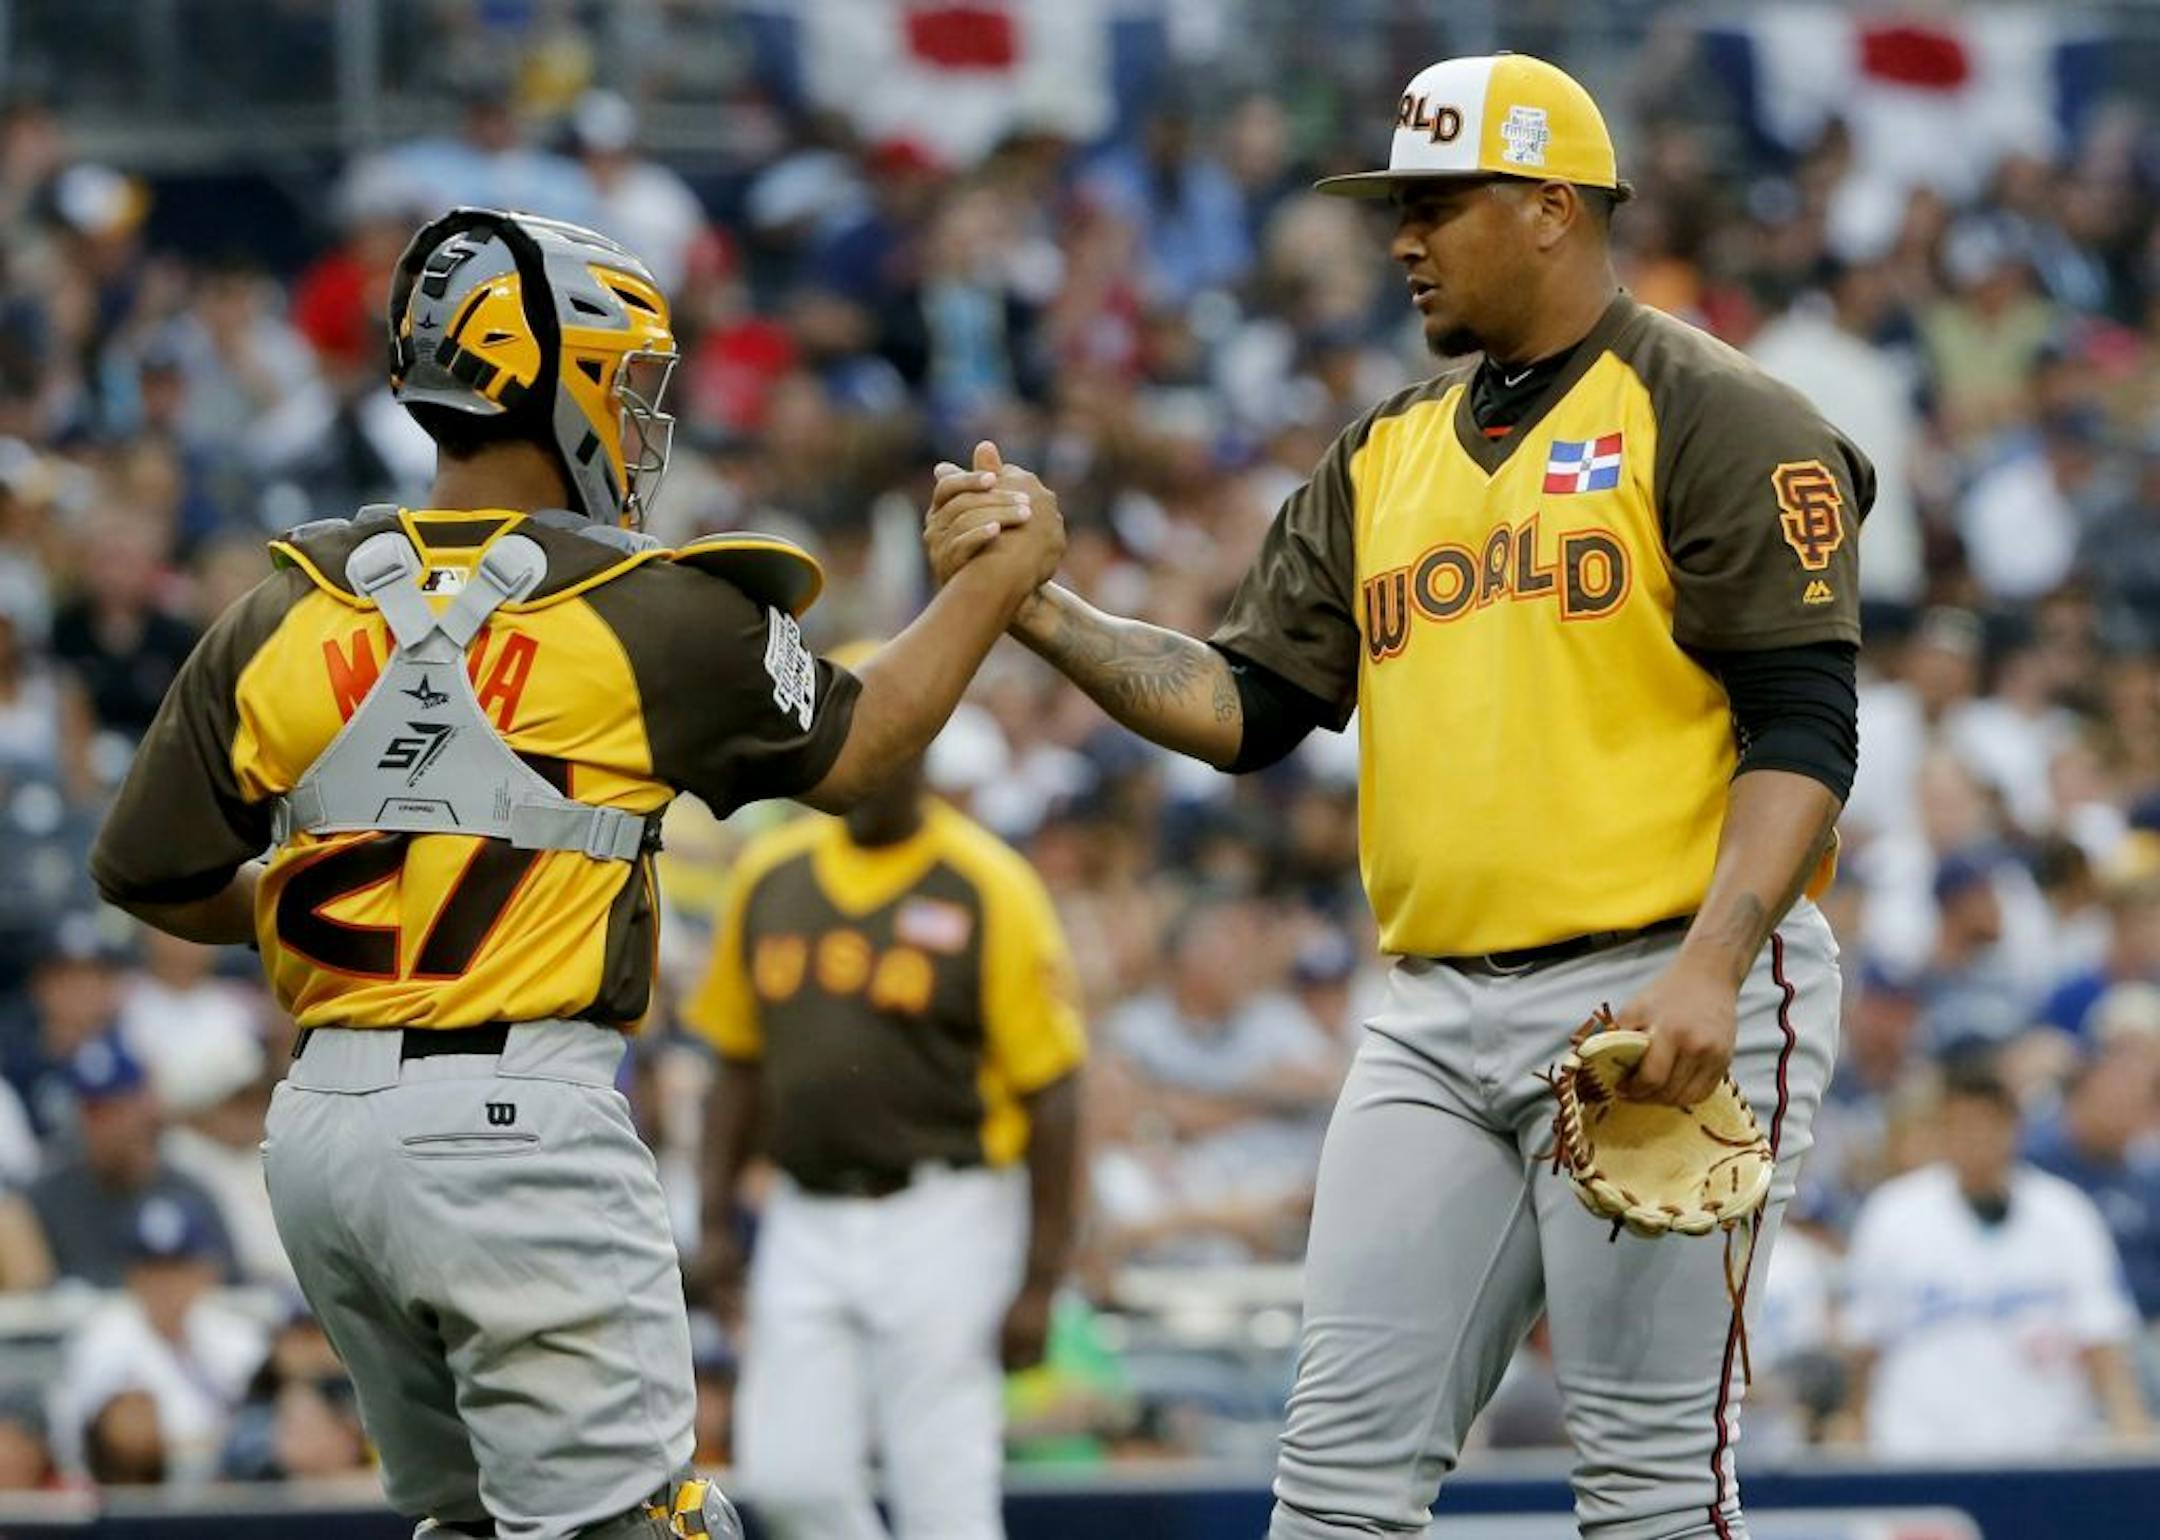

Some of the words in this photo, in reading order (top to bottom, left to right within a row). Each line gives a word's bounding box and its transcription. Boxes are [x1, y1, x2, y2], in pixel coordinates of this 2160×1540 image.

[1396, 93, 1464, 143] RLD
[1363, 511, 1632, 664] WORLD
[322, 625, 539, 735] MIA
[276, 746, 575, 981] 27
[754, 928, 936, 1017] USA
